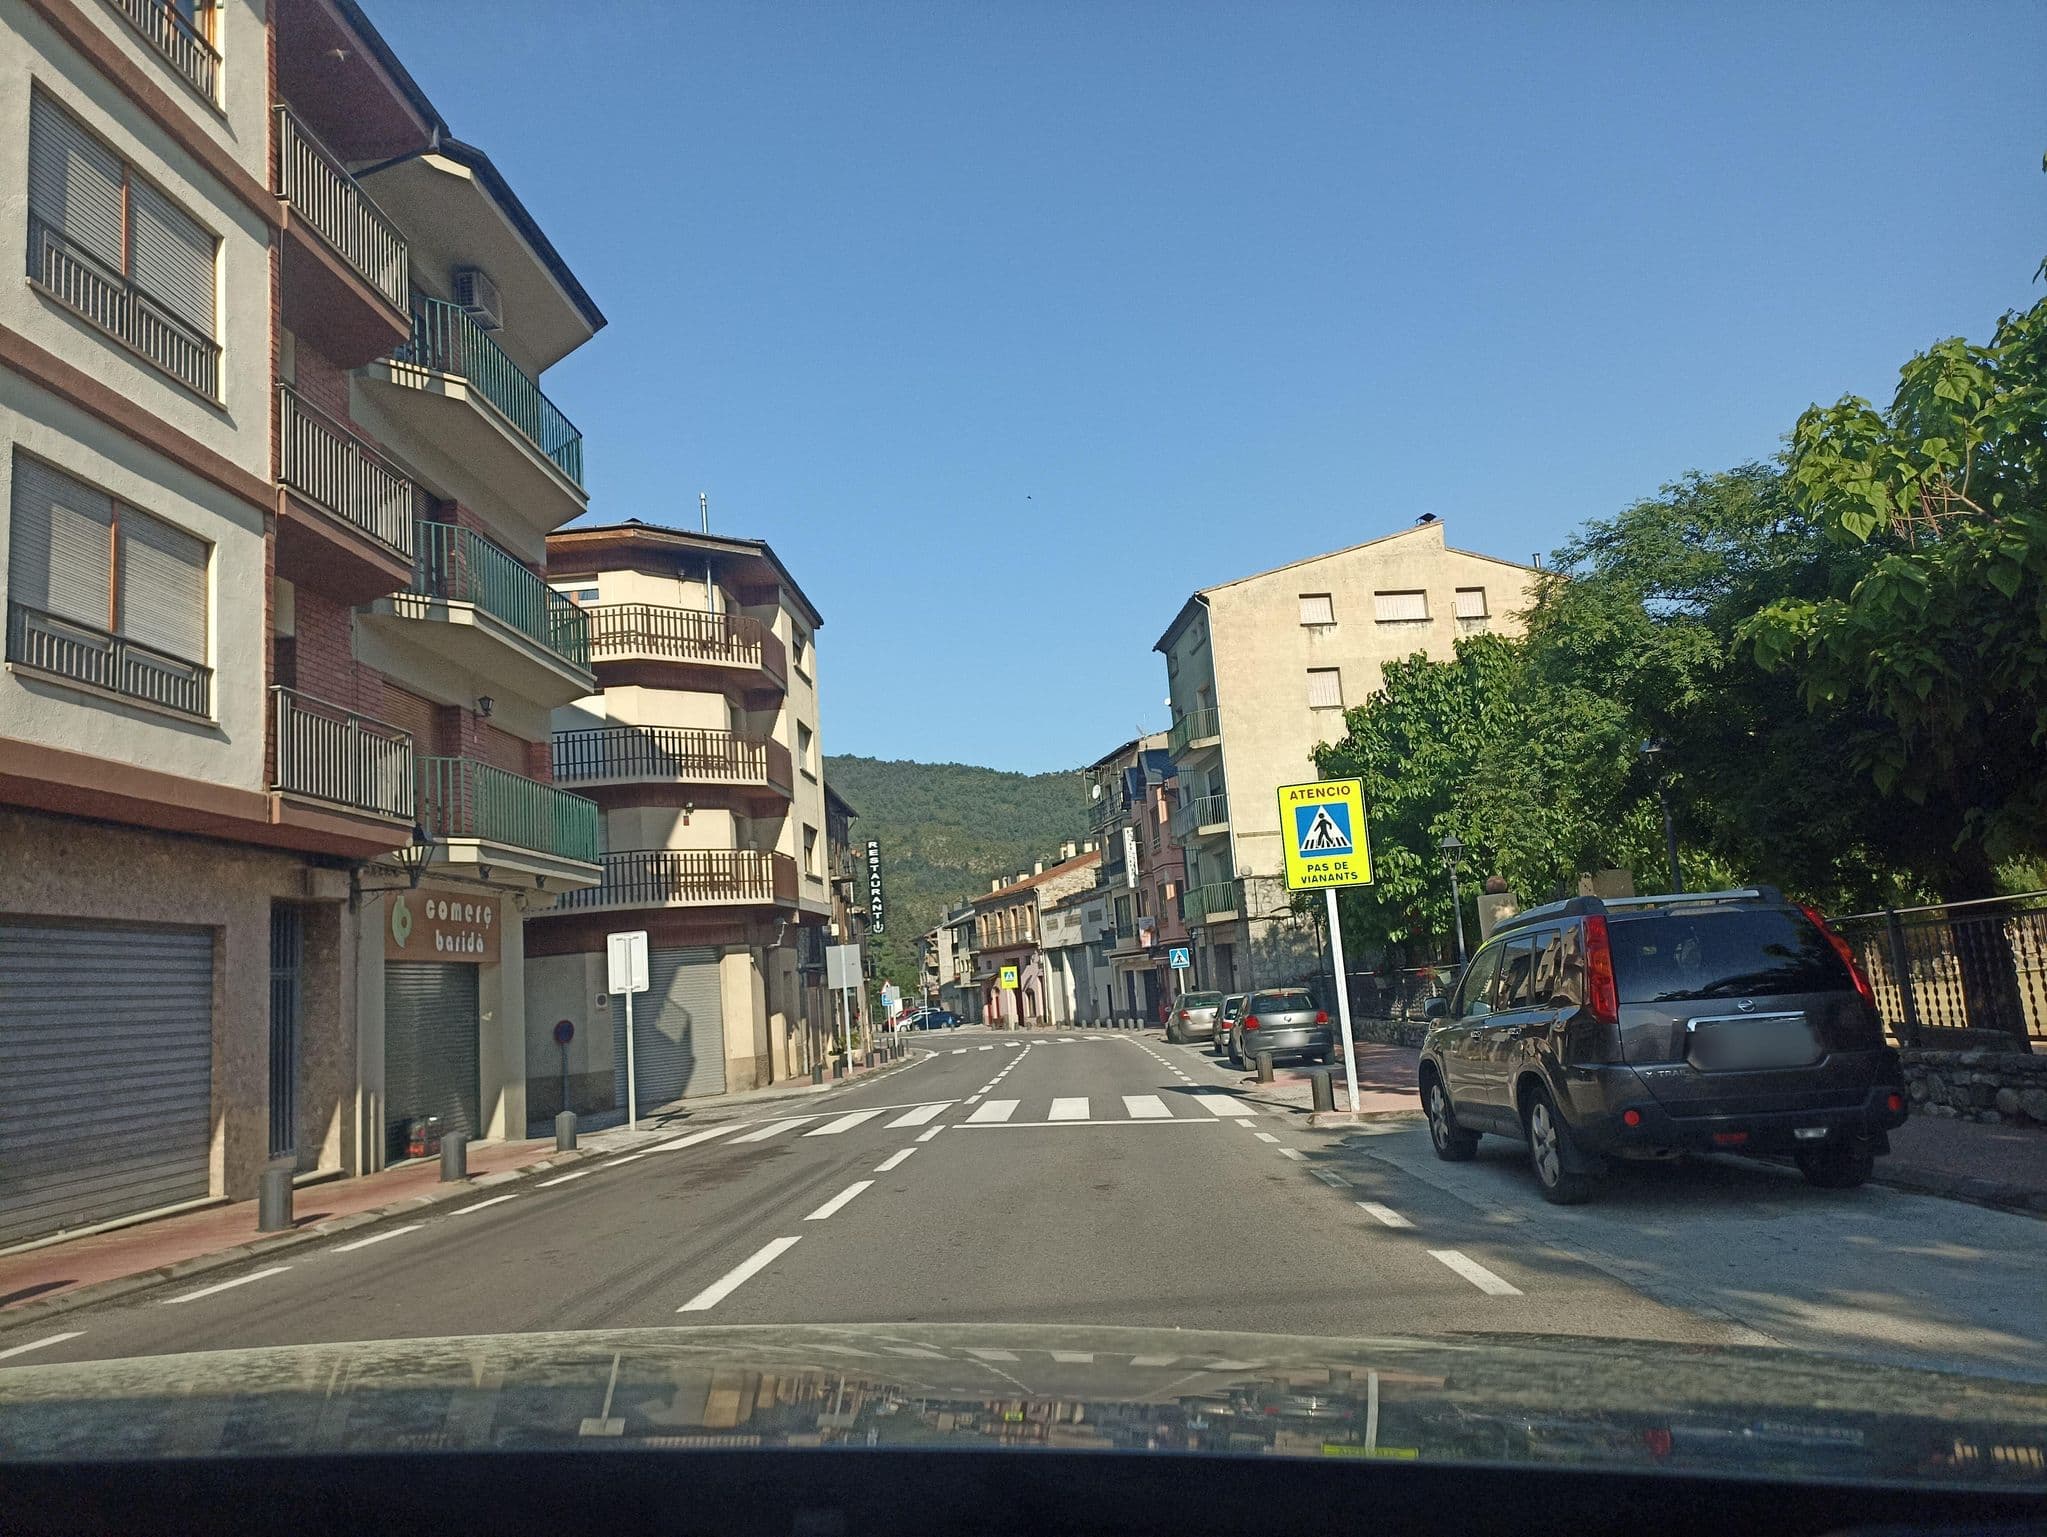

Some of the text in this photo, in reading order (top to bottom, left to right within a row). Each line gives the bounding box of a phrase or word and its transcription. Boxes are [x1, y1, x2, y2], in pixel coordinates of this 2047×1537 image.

[1290, 785, 1351, 801] ATENCIO
[1307, 861, 1349, 873] PAS DE
[868, 841, 883, 919] RESTAURANT
[1301, 872, 1358, 884] VIANANTS
[425, 899, 492, 929] comerç
[435, 929, 484, 953] baridà
